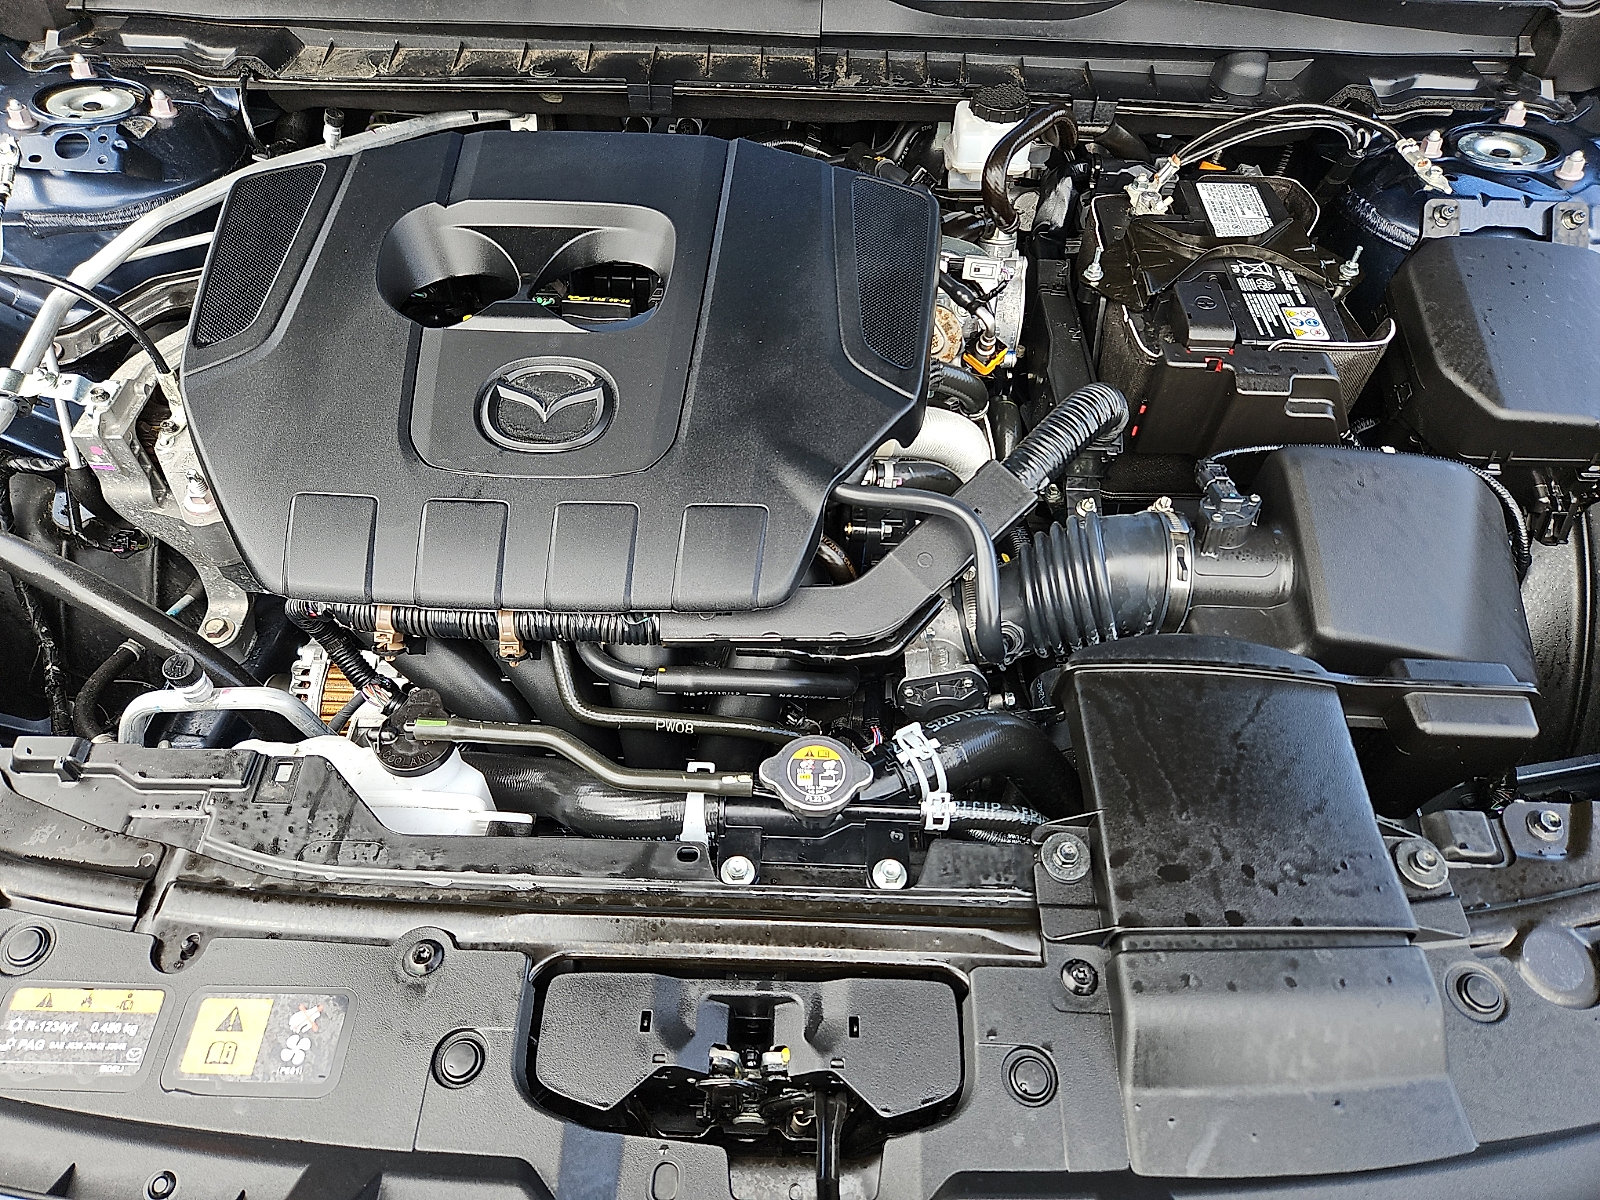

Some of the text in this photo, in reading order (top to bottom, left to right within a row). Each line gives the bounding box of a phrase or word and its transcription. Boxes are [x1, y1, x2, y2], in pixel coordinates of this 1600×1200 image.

[655, 719, 694, 734] PW08
[382, 750, 434, 767] COOLANT
[17, 1038, 46, 1051] PAG
